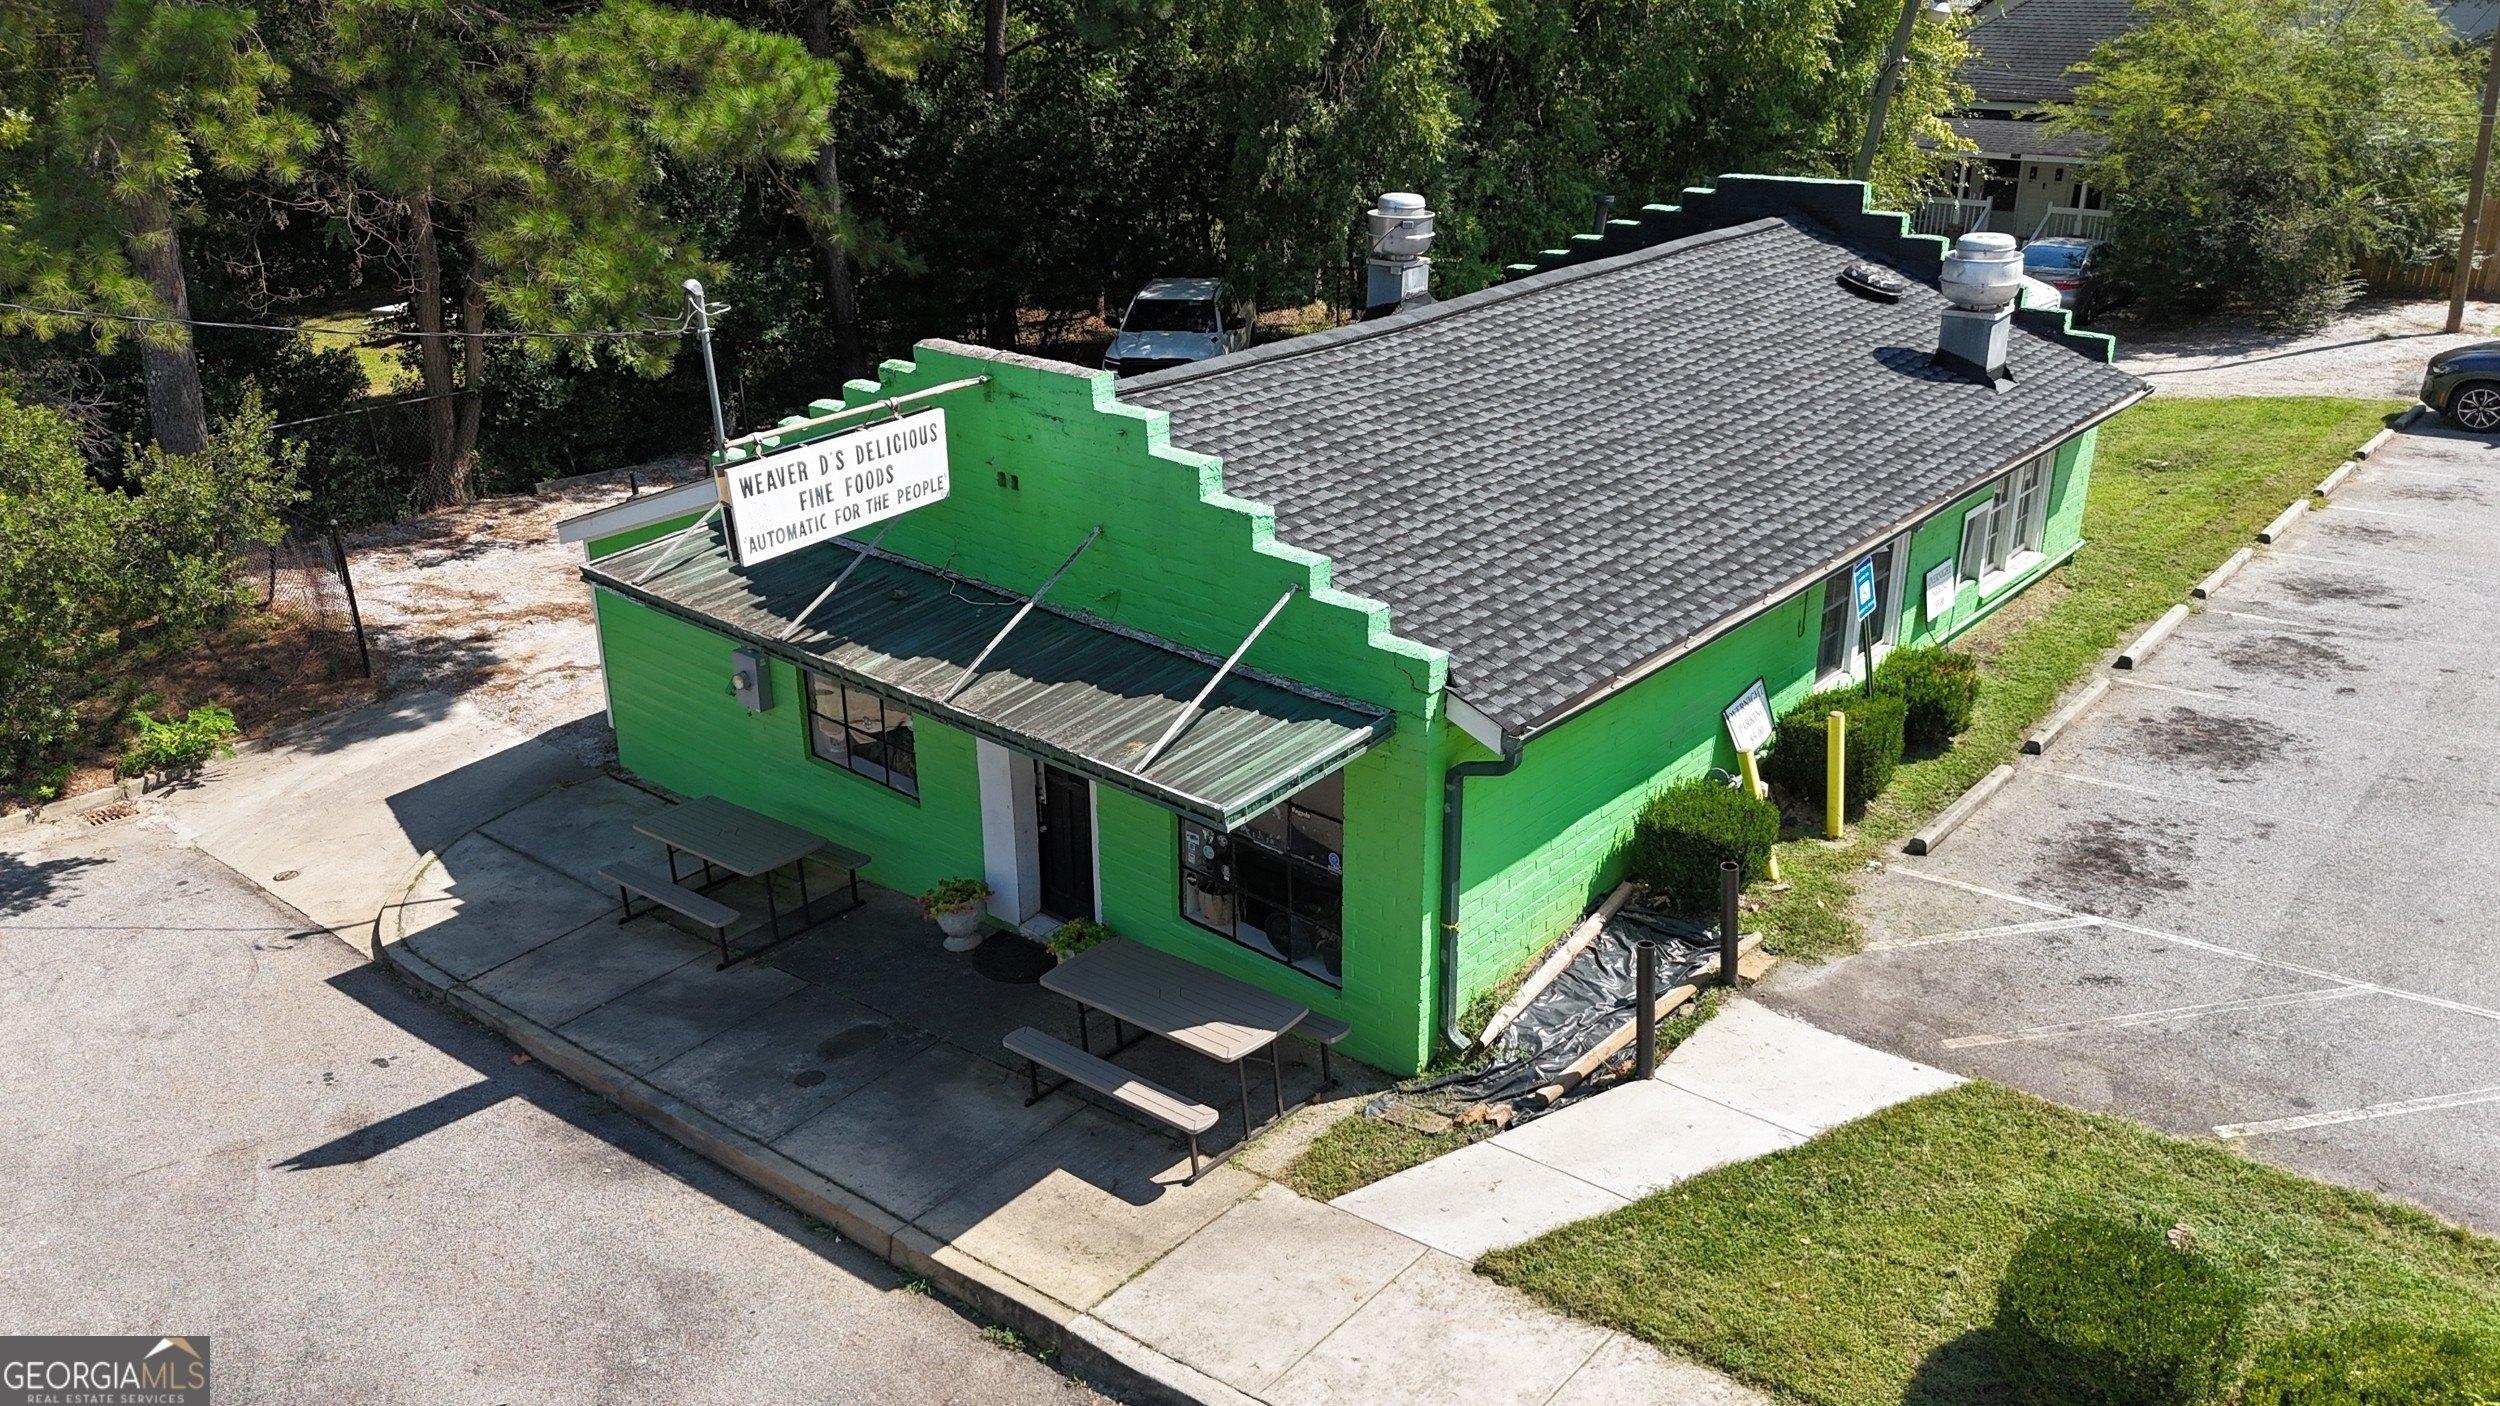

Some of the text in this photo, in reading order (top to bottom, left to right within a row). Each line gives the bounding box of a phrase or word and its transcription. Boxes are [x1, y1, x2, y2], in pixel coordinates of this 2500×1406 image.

[738, 422, 938, 499] WEAVER D'S DELICIOUS
[798, 464, 895, 511] FINE FOODS
[834, 505, 861, 526] FOR
[865, 493, 890, 515] THE
